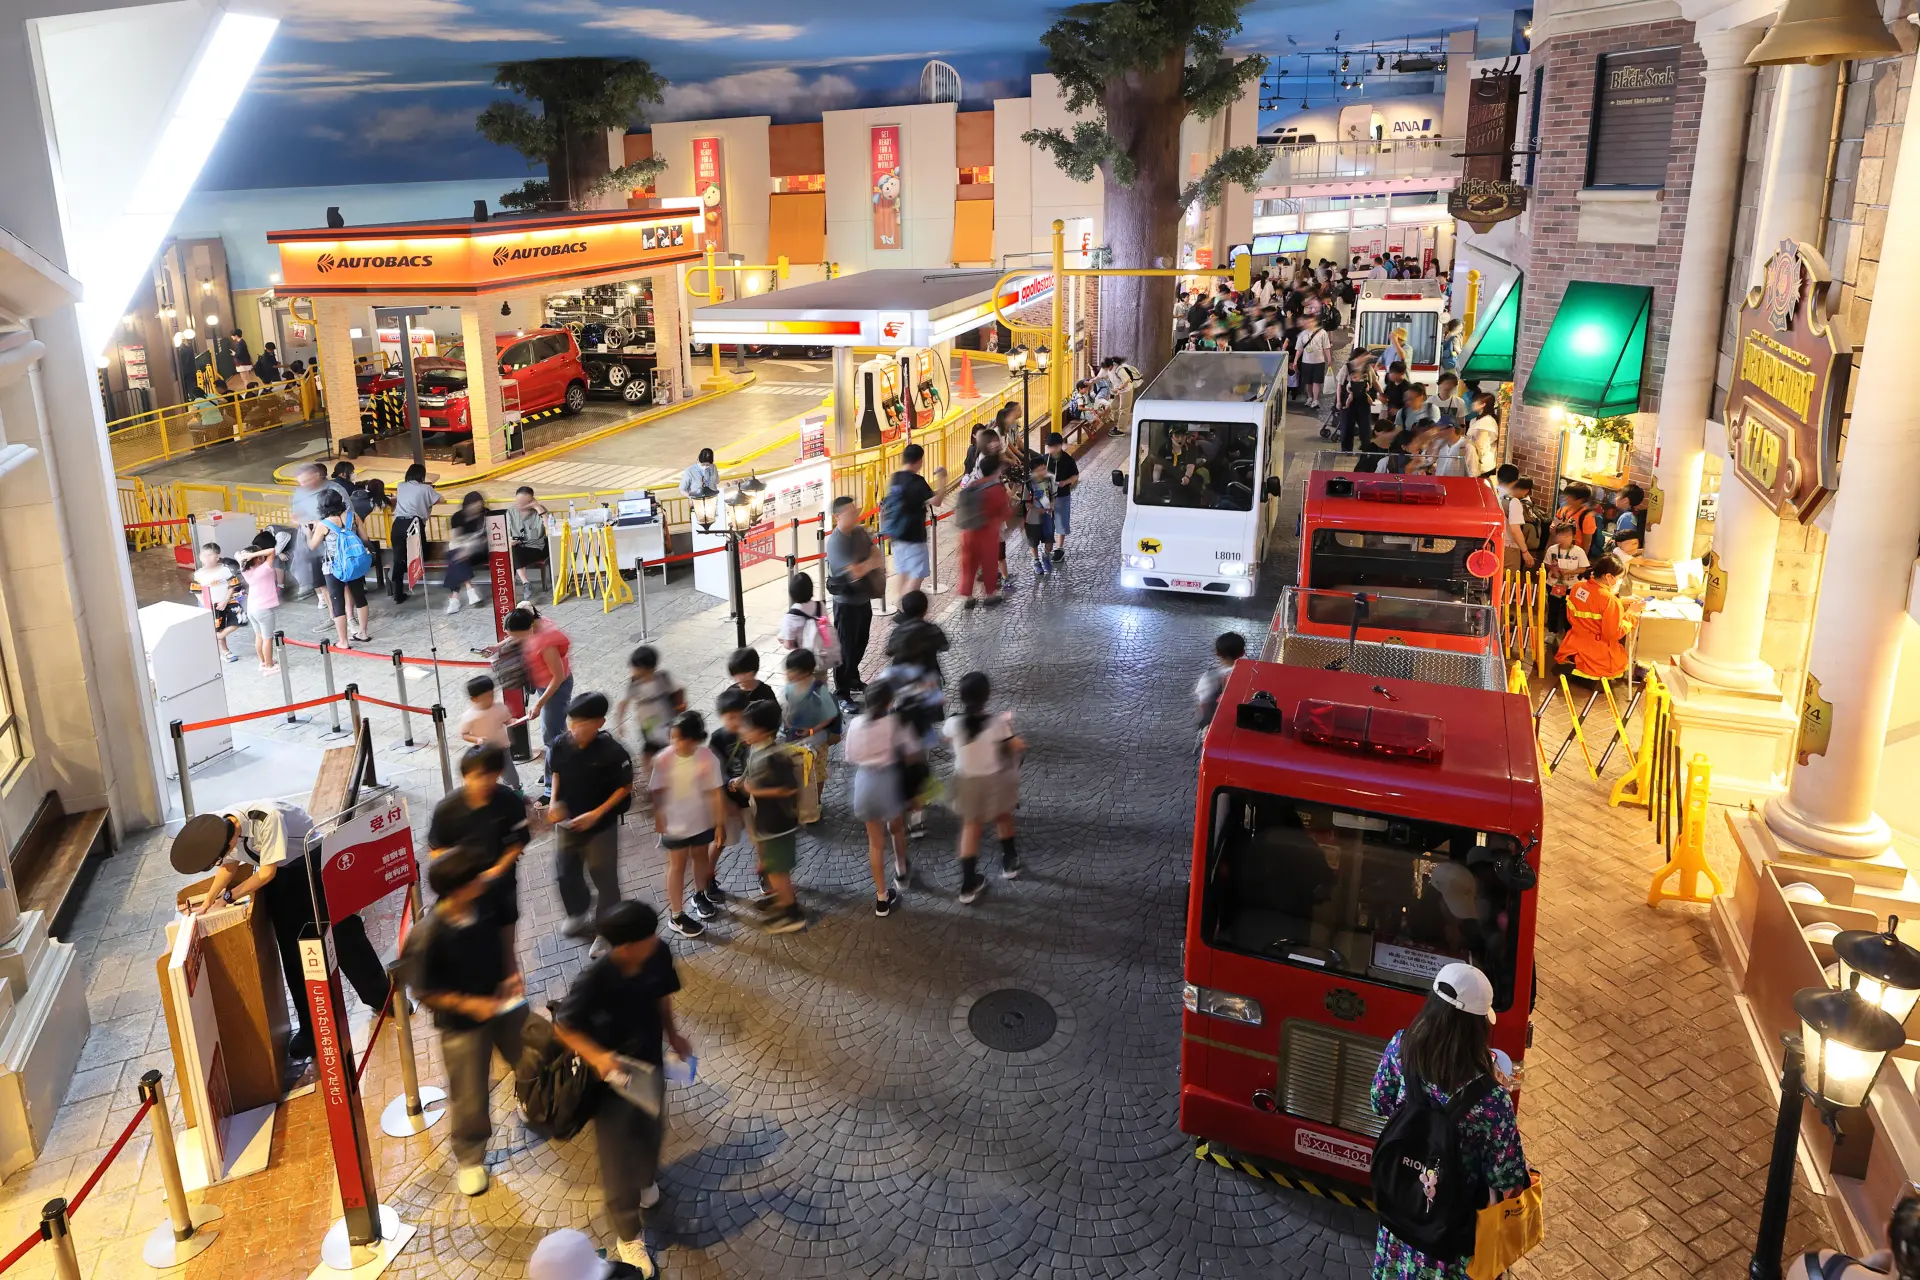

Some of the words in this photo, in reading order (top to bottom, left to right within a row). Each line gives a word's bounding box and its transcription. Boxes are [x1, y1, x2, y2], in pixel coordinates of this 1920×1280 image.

[1610, 69, 1643, 90] Black
[1644, 65, 1675, 87] Soak
[1616, 98, 1633, 106] Instant
[1646, 96, 1663, 104] Repair
[1393, 120, 1421, 133] ANA
[1467, 127, 1504, 149] SHOP
[1460, 180, 1492, 196] Black
[1491, 179, 1520, 195] Soak
[510, 241, 588, 261] AUTOBACS
[336, 255, 433, 269] AUTOBACS
[491, 522, 502, 541] 入口
[1215, 550, 1241, 561] L8010
[370, 807, 401, 833] 受付
[307, 946, 319, 967] 入口
[312, 985, 343, 1106] こちらからお並びください
[1312, 1139, 1368, 1164] XAL-404
